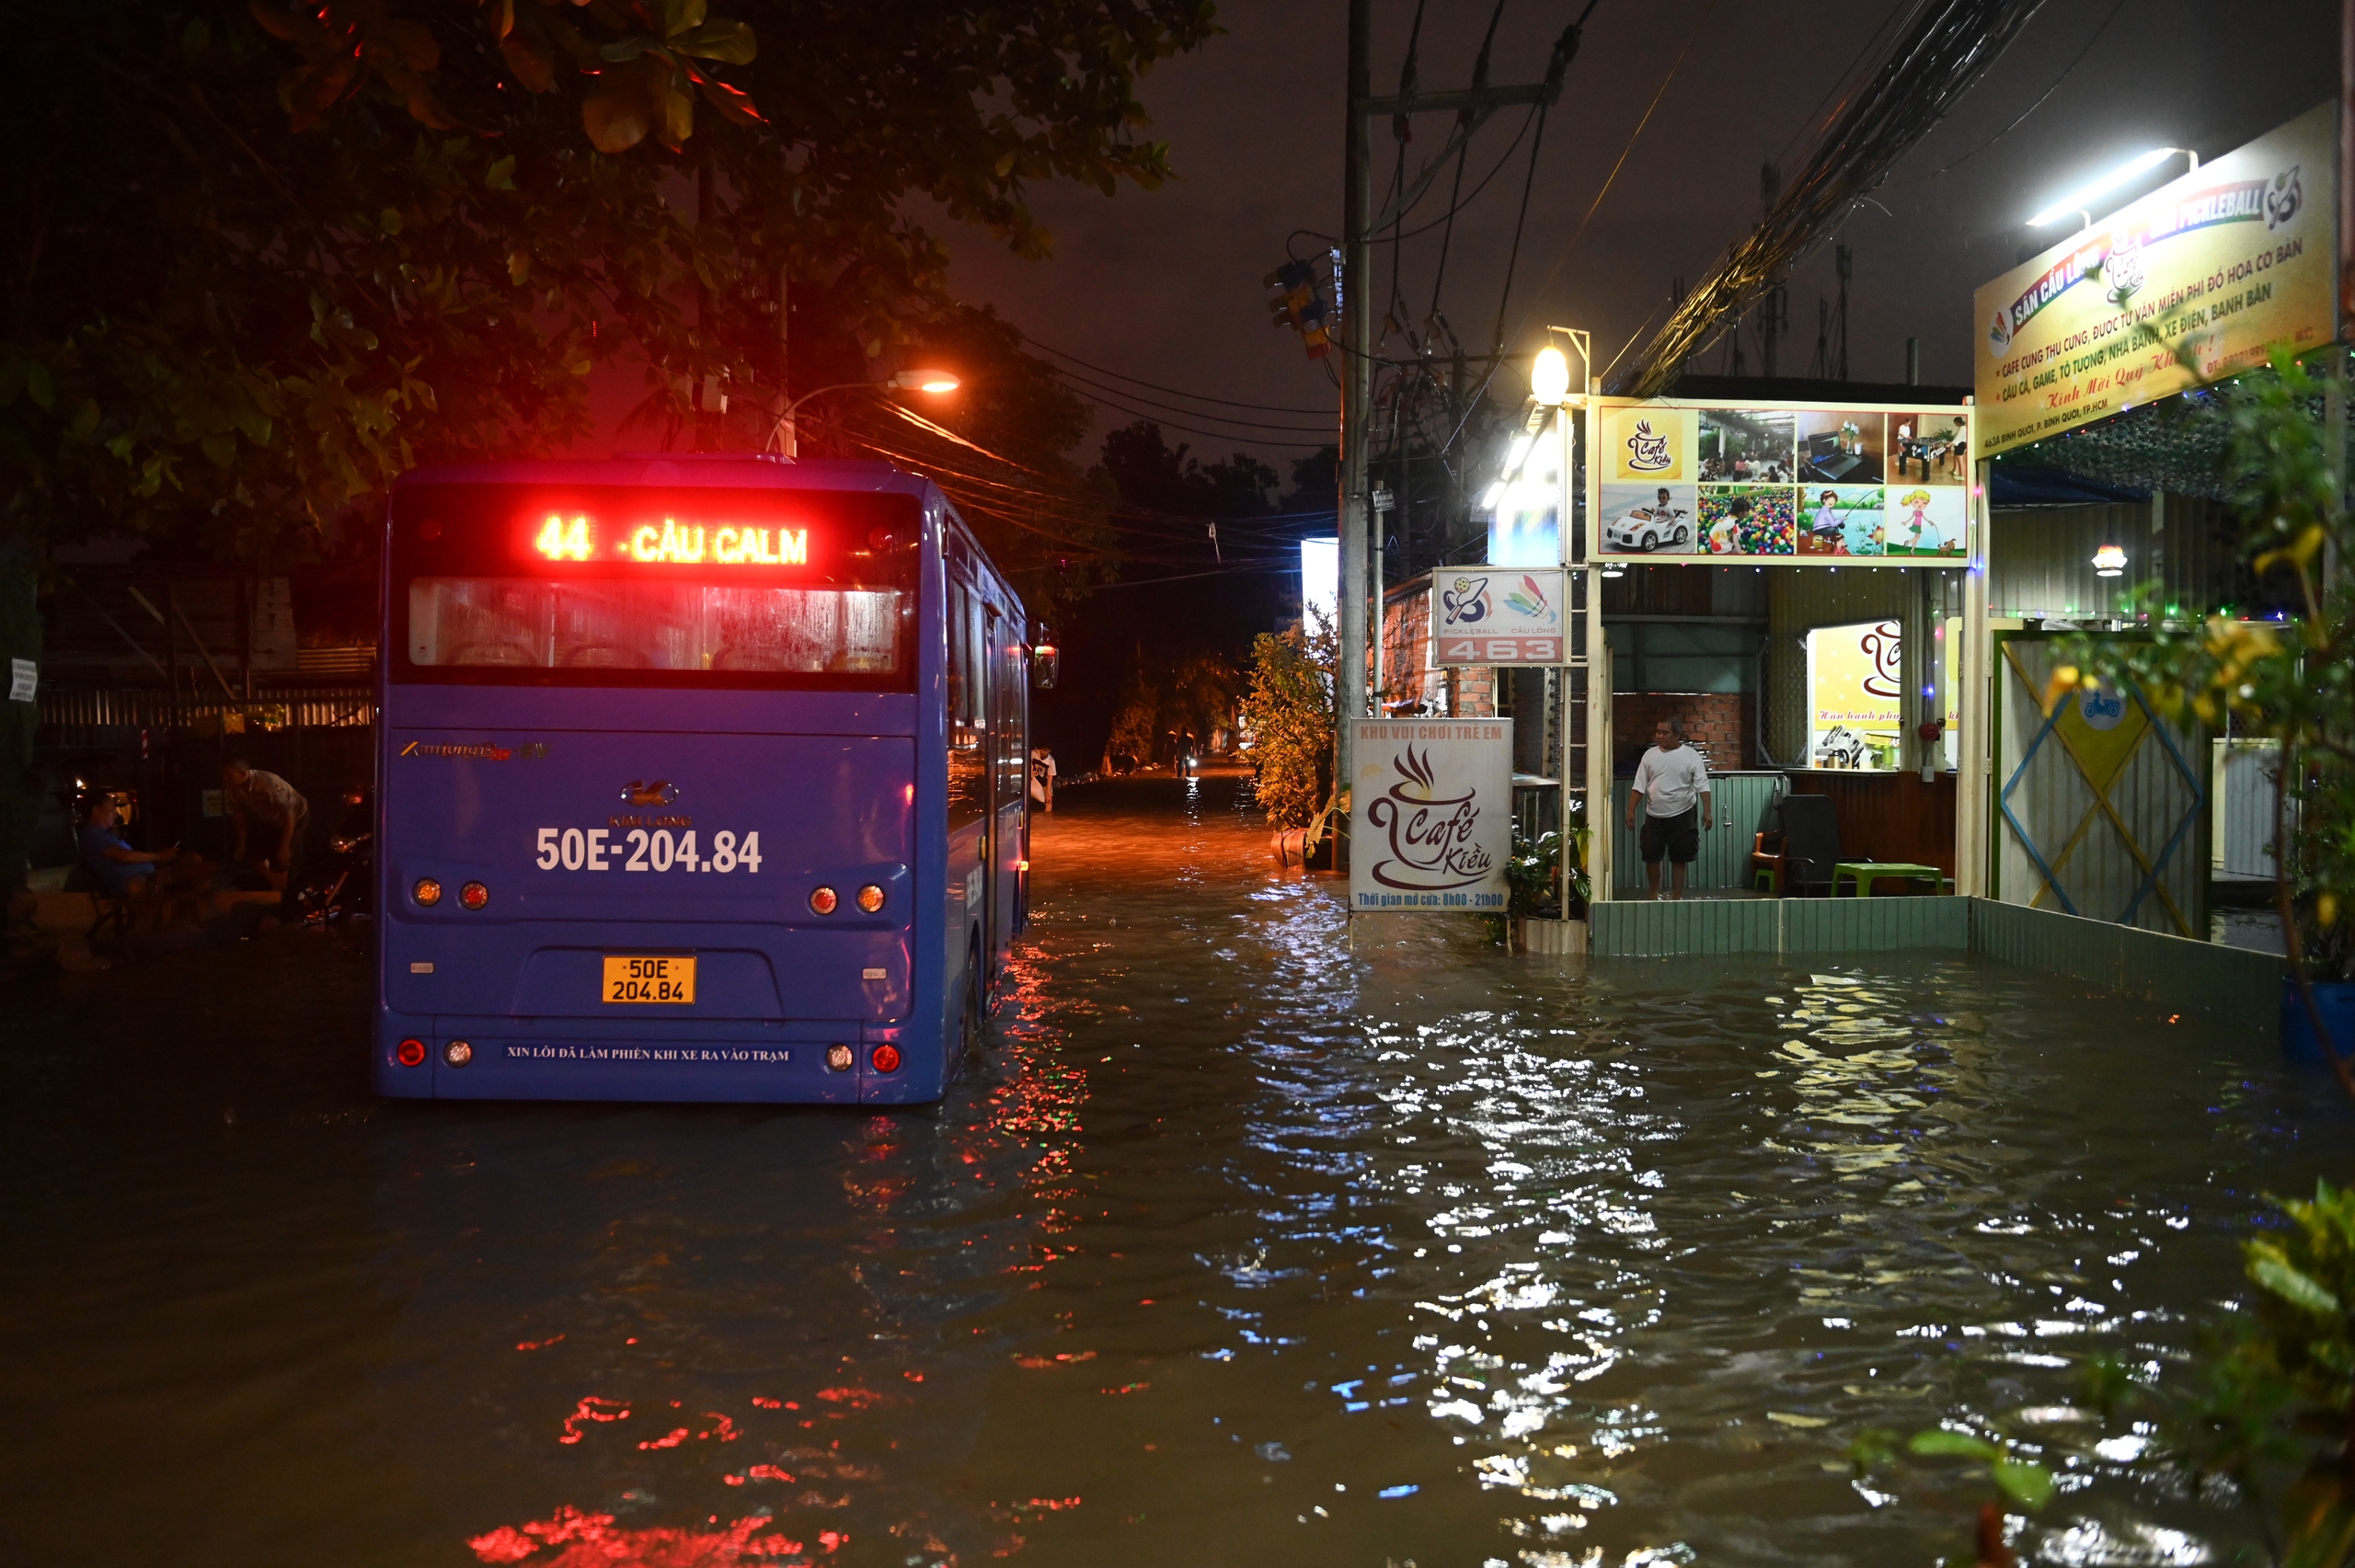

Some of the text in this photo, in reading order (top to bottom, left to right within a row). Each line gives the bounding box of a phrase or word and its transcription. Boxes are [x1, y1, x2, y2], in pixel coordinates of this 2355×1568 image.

[2179, 189, 2259, 228] PICKLEBALL
[2016, 290, 2039, 326] SÂN
[2040, 268, 2064, 303] CẦU
[2120, 310, 2133, 328] TƯ
[2187, 277, 2204, 301] PHÍ
[2227, 259, 2253, 284] HỌA
[2257, 250, 2273, 272] CƠ
[2033, 369, 2057, 390] GAME,
[2060, 361, 2071, 379] TÔ
[2165, 320, 2177, 339] XE
[2179, 309, 2209, 333] ĐIỆN,
[2211, 293, 2243, 321] BANH
[2046, 385, 2080, 410] Kính
[2083, 375, 2110, 397] Mời
[2116, 363, 2143, 386] Quý
[1984, 436, 2000, 449] 463A
[2037, 421, 2043, 431] P.
[2083, 398, 2108, 416] TP.HCM
[1640, 438, 1667, 462] Café
[537, 516, 592, 561] 44
[714, 527, 808, 564] CALM
[1447, 639, 1556, 660] 463
[1361, 723, 1502, 739] KHU VUI CHƠI TRẺ EM
[1819, 710, 1844, 721] Hân
[1846, 710, 1876, 722] hạnh
[608, 815, 692, 828] KIM LONG
[1406, 801, 1480, 864] Café
[536, 828, 763, 873] 50E-204.84
[1442, 842, 1493, 876] Kiều
[1359, 892, 1379, 906] Thời
[1381, 893, 1402, 907] gian
[1405, 892, 1419, 906] mở
[1421, 892, 1441, 906] cửa:
[1443, 893, 1467, 906] 8h00
[1475, 893, 1503, 906] 21h00
[629, 960, 669, 979] 50E
[612, 981, 684, 1001] 204.84
[508, 1047, 530, 1057] XIN
[558, 1046, 576, 1058] ĐÃ
[654, 1049, 677, 1059] KHI
[681, 1050, 698, 1060] XE
[701, 1050, 718, 1060] RA
[721, 1047, 749, 1060] VÀO
[752, 1050, 789, 1063] TRẠM
